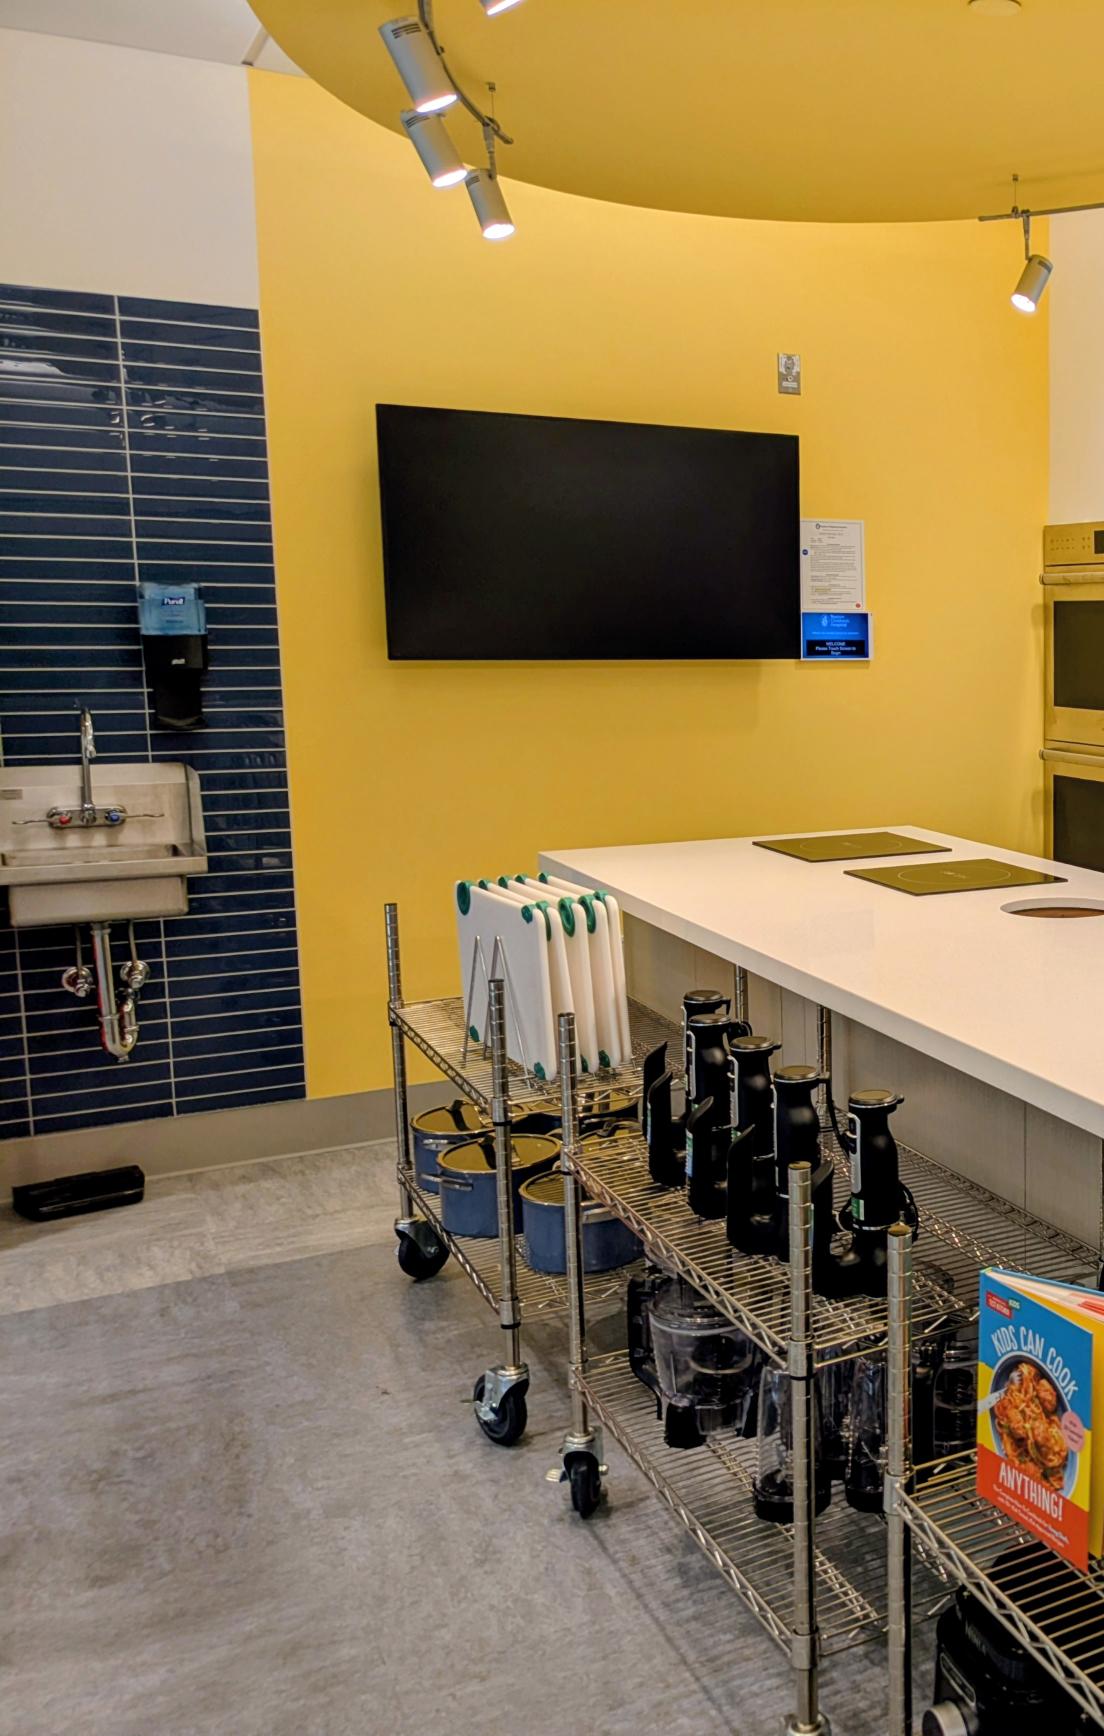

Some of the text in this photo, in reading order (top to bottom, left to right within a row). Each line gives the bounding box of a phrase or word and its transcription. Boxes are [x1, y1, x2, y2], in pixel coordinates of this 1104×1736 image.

[990, 1324, 1079, 1401] KIDS CAN COOK
[999, 1461, 1064, 1522] ANYTHING!
